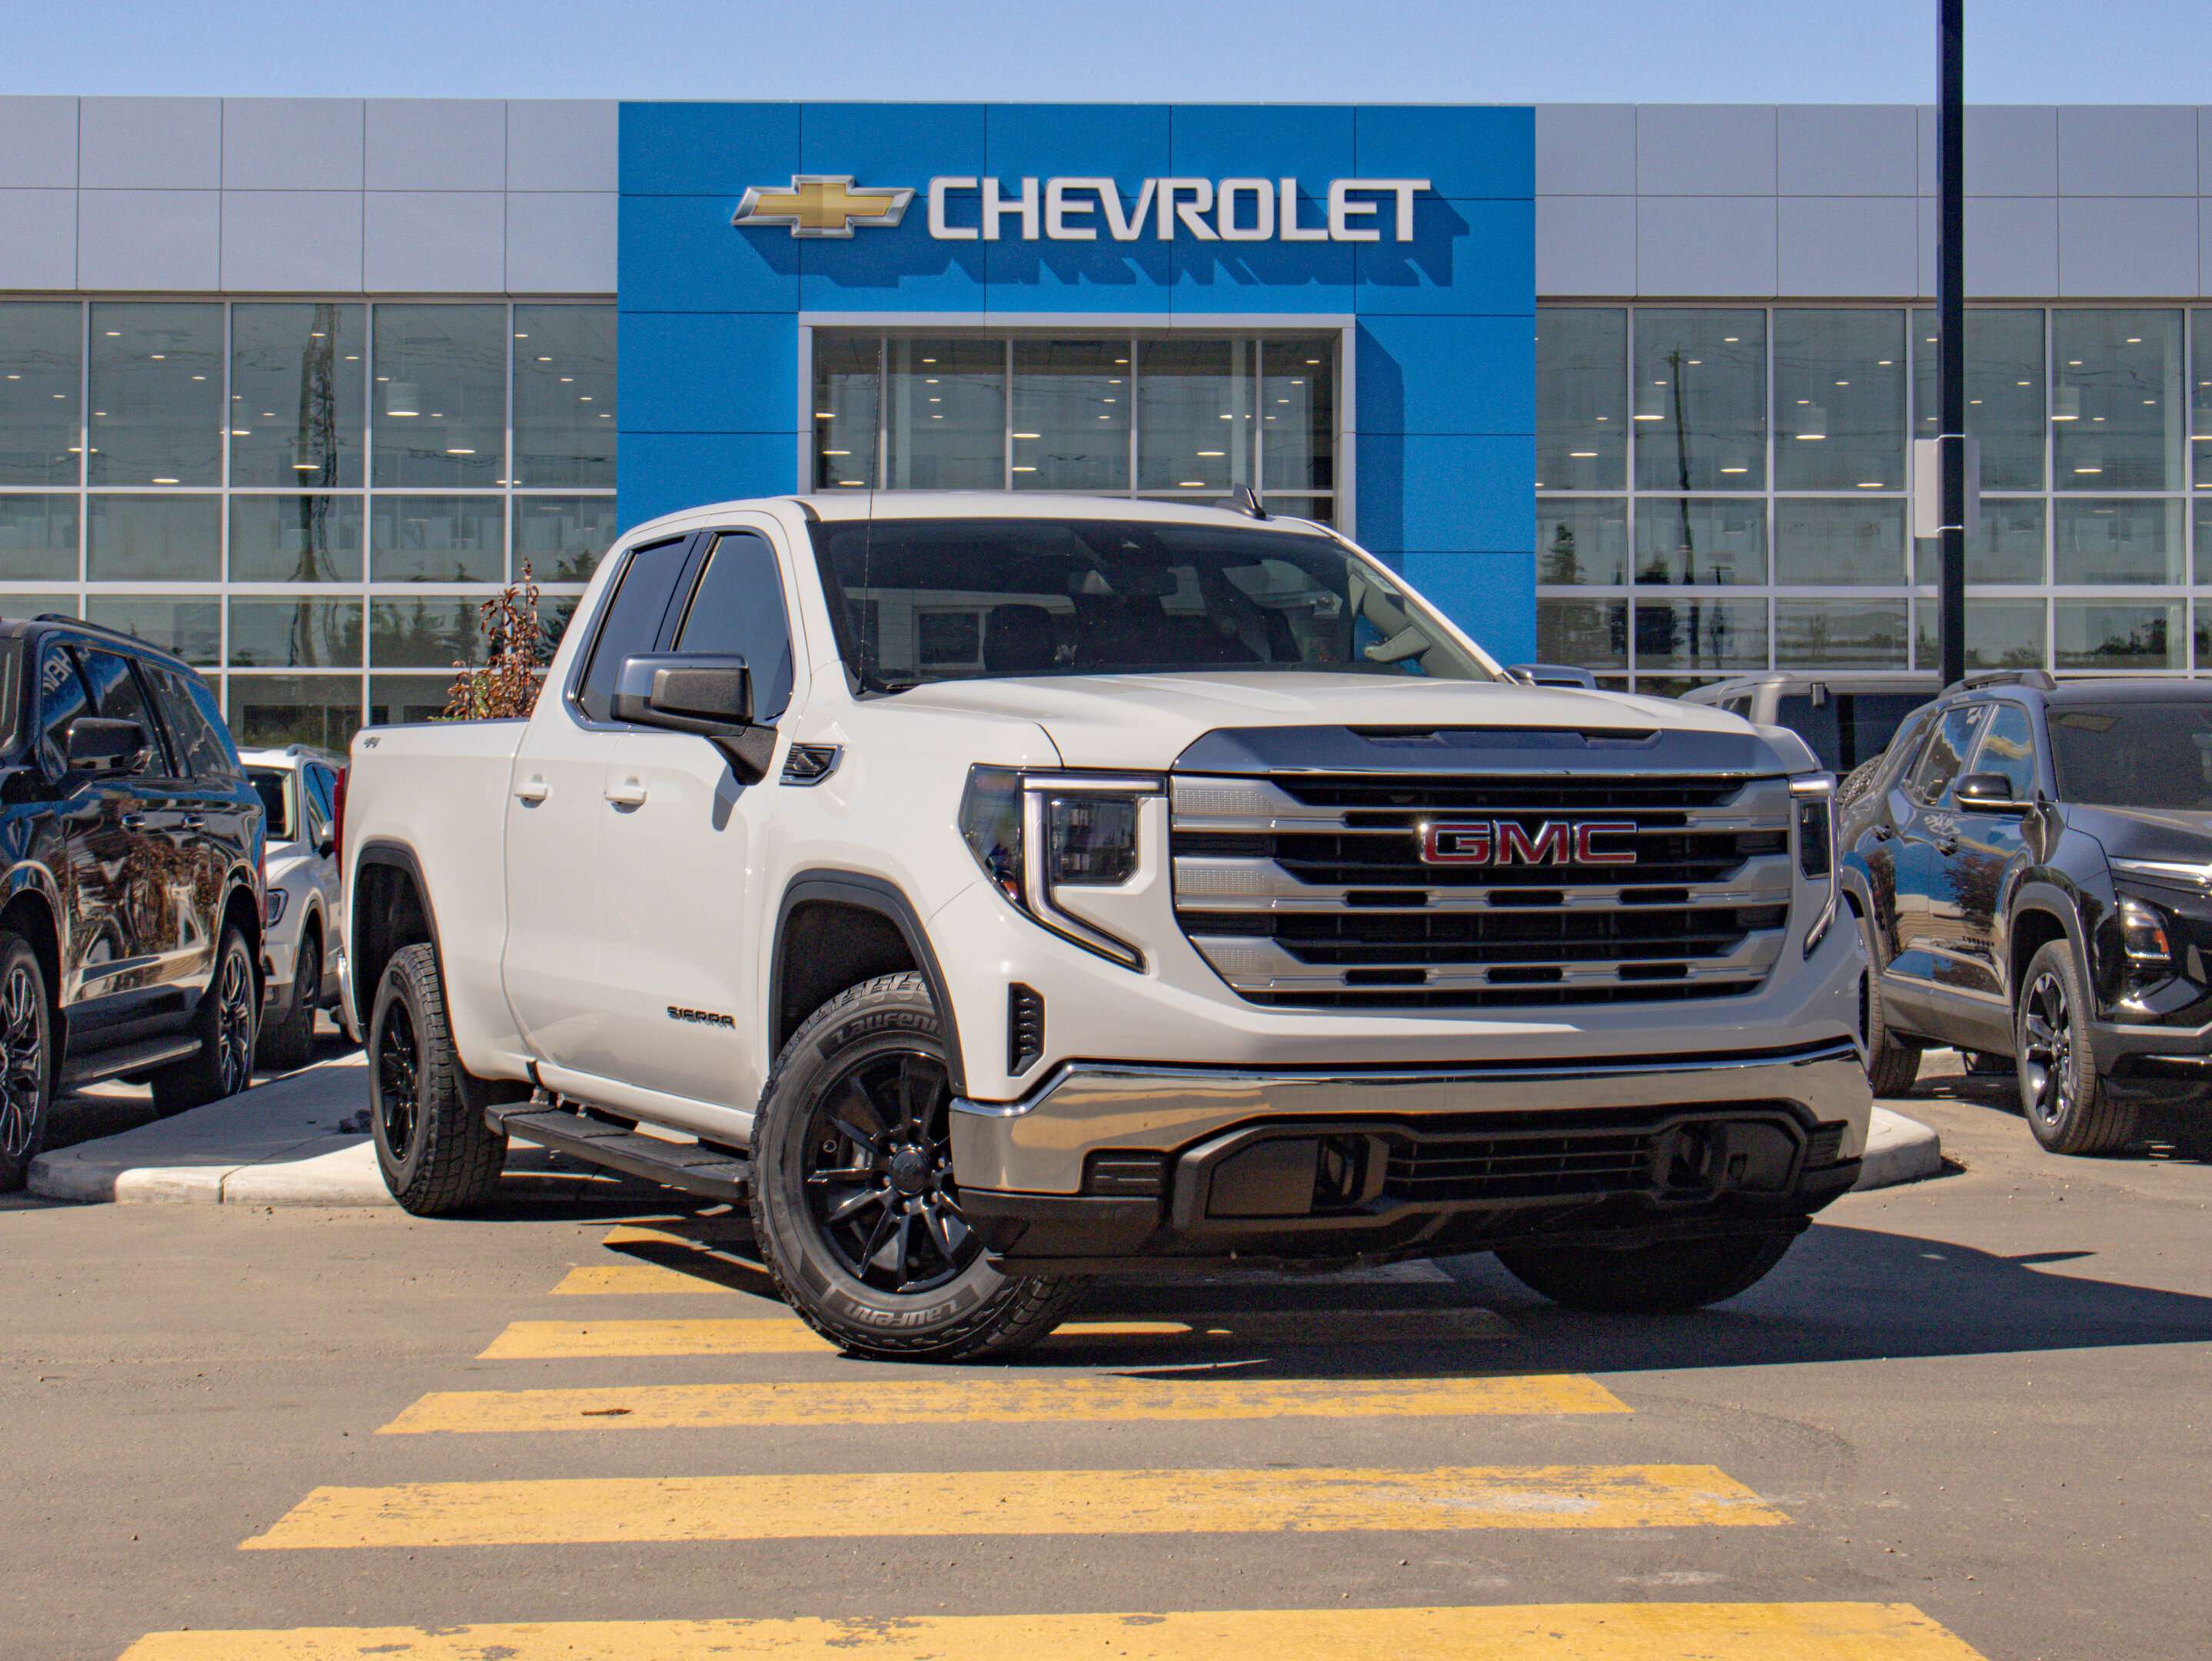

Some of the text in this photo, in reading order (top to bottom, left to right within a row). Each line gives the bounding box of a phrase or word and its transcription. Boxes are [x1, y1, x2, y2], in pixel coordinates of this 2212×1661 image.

[928, 176, 1432, 241] CHEVROLET
[1420, 820, 1638, 866] GMC
[667, 1006, 736, 1030] SIERRA
